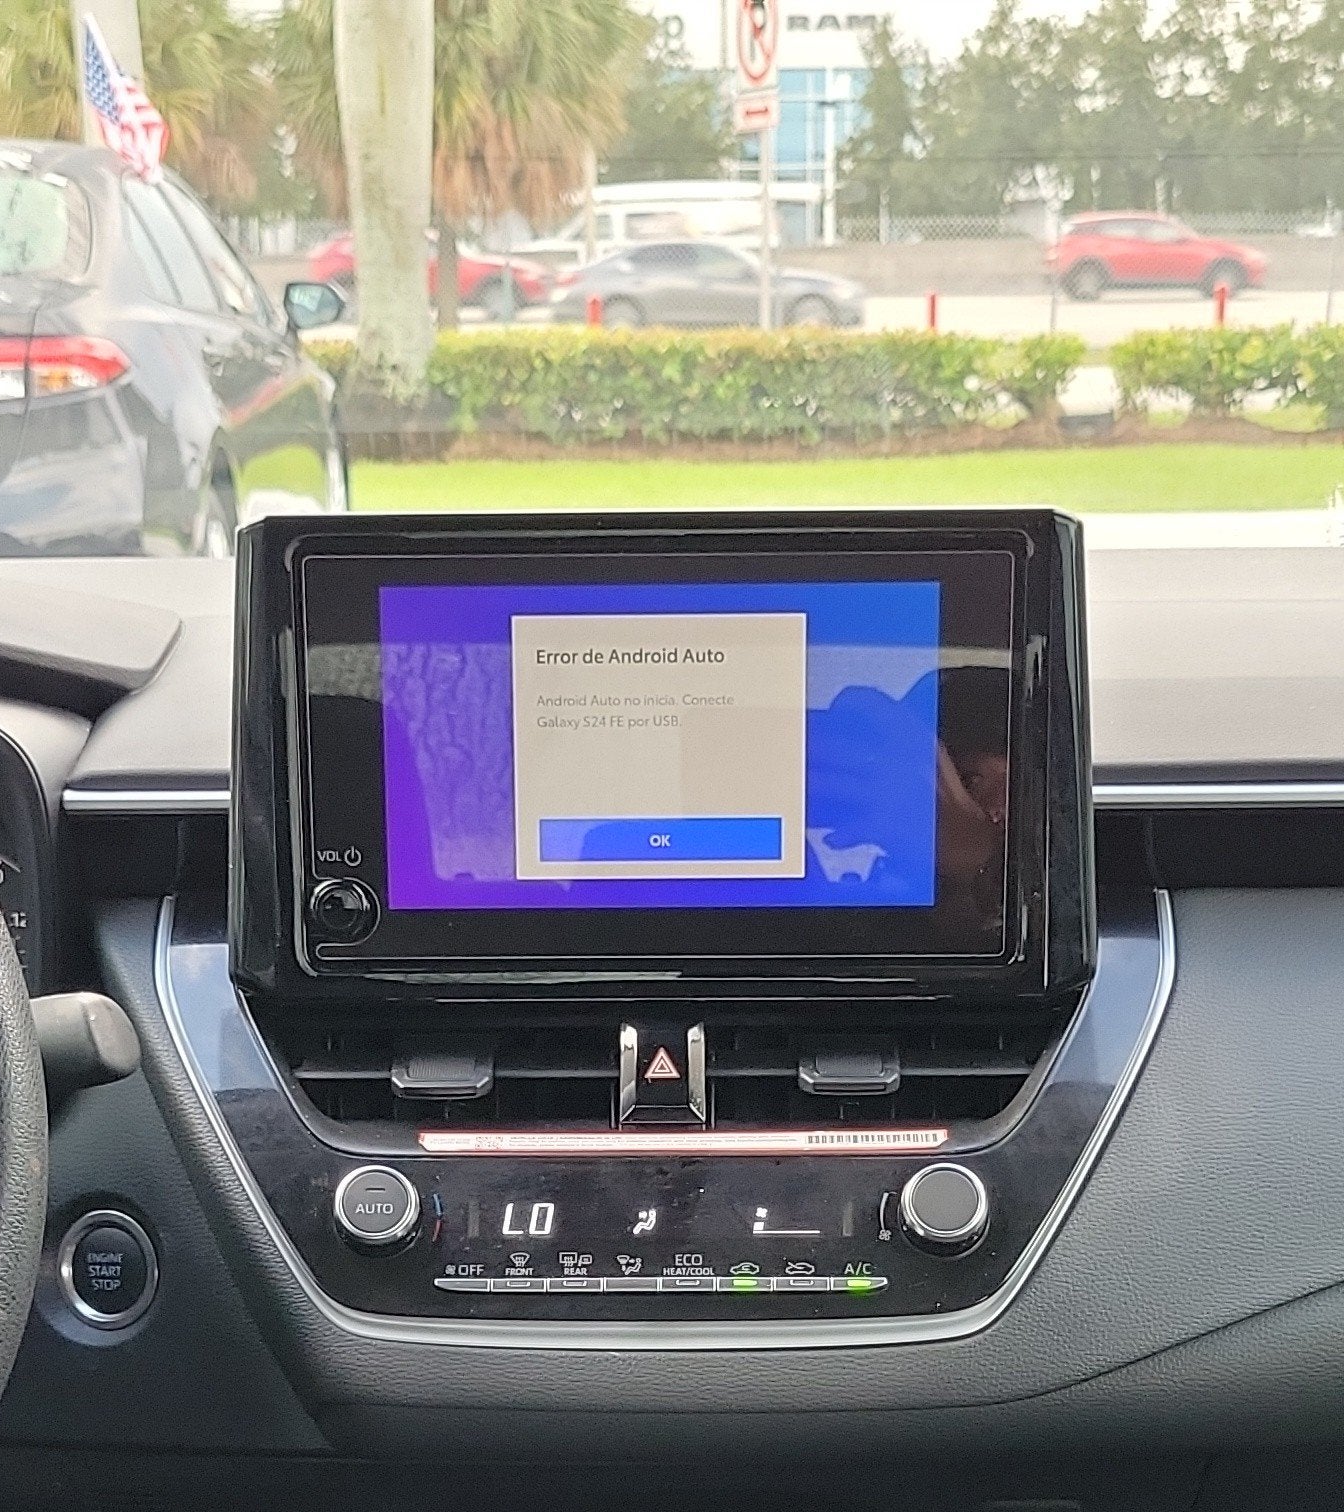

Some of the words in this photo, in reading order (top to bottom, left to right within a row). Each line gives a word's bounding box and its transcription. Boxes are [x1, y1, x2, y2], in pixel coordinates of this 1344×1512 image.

[787, 15, 876, 31] RAM
[536, 649, 578, 665] Error
[582, 648, 604, 665] de
[608, 648, 678, 665] Android
[682, 648, 725, 664] Auto
[536, 695, 587, 707] Android
[590, 695, 621, 707] Auto
[624, 697, 641, 706] no
[644, 694, 678, 706] inicia.
[682, 693, 735, 706] Conecte
[537, 716, 580, 730] Galaxy
[583, 716, 606, 728] S24
[610, 716, 624, 727] FE
[627, 718, 650, 730] por
[653, 715, 682, 728] USB.
[649, 834, 671, 847] OK
[317, 850, 343, 862] VOL
[355, 1203, 394, 1215] AUTO
[87, 1252, 124, 1263] ENGINE
[674, 1254, 703, 1267] ECO
[88, 1265, 122, 1277] START
[458, 1265, 485, 1276] OFF
[505, 1267, 534, 1276] FRONT
[563, 1267, 588, 1276] REAR
[663, 1267, 715, 1276] HEAT/COOL
[844, 1263, 872, 1275] A/C
[92, 1280, 122, 1291] STOP
